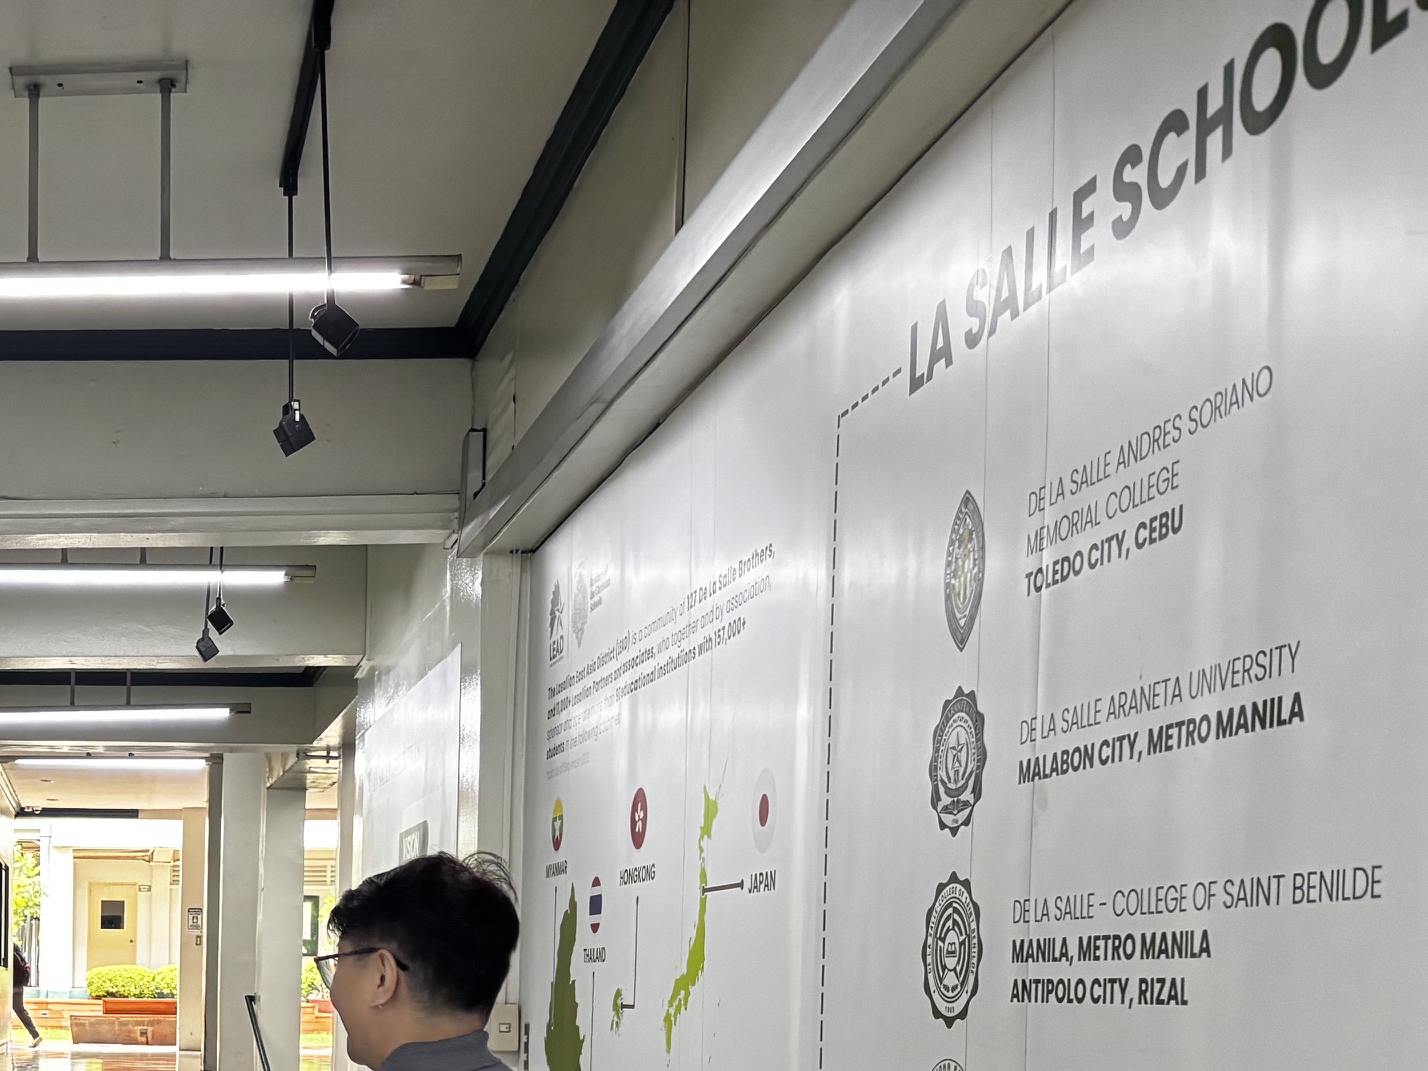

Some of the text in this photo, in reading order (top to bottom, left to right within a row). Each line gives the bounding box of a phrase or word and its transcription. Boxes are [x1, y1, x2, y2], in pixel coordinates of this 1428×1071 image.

[909, 0, 1428, 396] LA SALLE SCHOOL
[1029, 365, 1273, 517] DE LA SALLE ANDRES SORIANO
[1027, 460, 1180, 558] MEMORIAL COLLEGE
[1025, 504, 1183, 597] TOLEDO CITY, CEBU
[687, 589, 697, 611] 127
[698, 586, 707, 603] De
[709, 581, 716, 597] La
[718, 566, 736, 590] Salle
[738, 543, 775, 577] Brothers,
[549, 634, 564, 662] LEAD
[697, 634, 712, 656] with
[714, 617, 746, 647] 157,000+
[1020, 641, 1300, 745] DE LA SALLE ARANETA UNIVERSITY
[1018, 742, 1094, 785] MALABON
[1099, 732, 1142, 766] CITY,
[1147, 714, 1211, 756] METRO
[1215, 692, 1304, 740] MANILA
[546, 860, 567, 878] MYANMAR
[620, 864, 656, 886] HONGKONG
[748, 870, 776, 894] JAPAN
[1013, 898, 1030, 924] DE
[1035, 897, 1050, 922] LA
[1054, 893, 1095, 921] SALLE
[1113, 884, 1188, 917] COLLEGE
[1193, 881, 1217, 910] OF
[1223, 874, 1286, 909] SAINT
[1292, 865, 1382, 905] BENILDE
[583, 947, 606, 963] THAILAND
[1011, 929, 1211, 966] MANILA, METRO MANILA
[1010, 978, 1188, 1009] ANTIPOLO CITY, RIZAL
